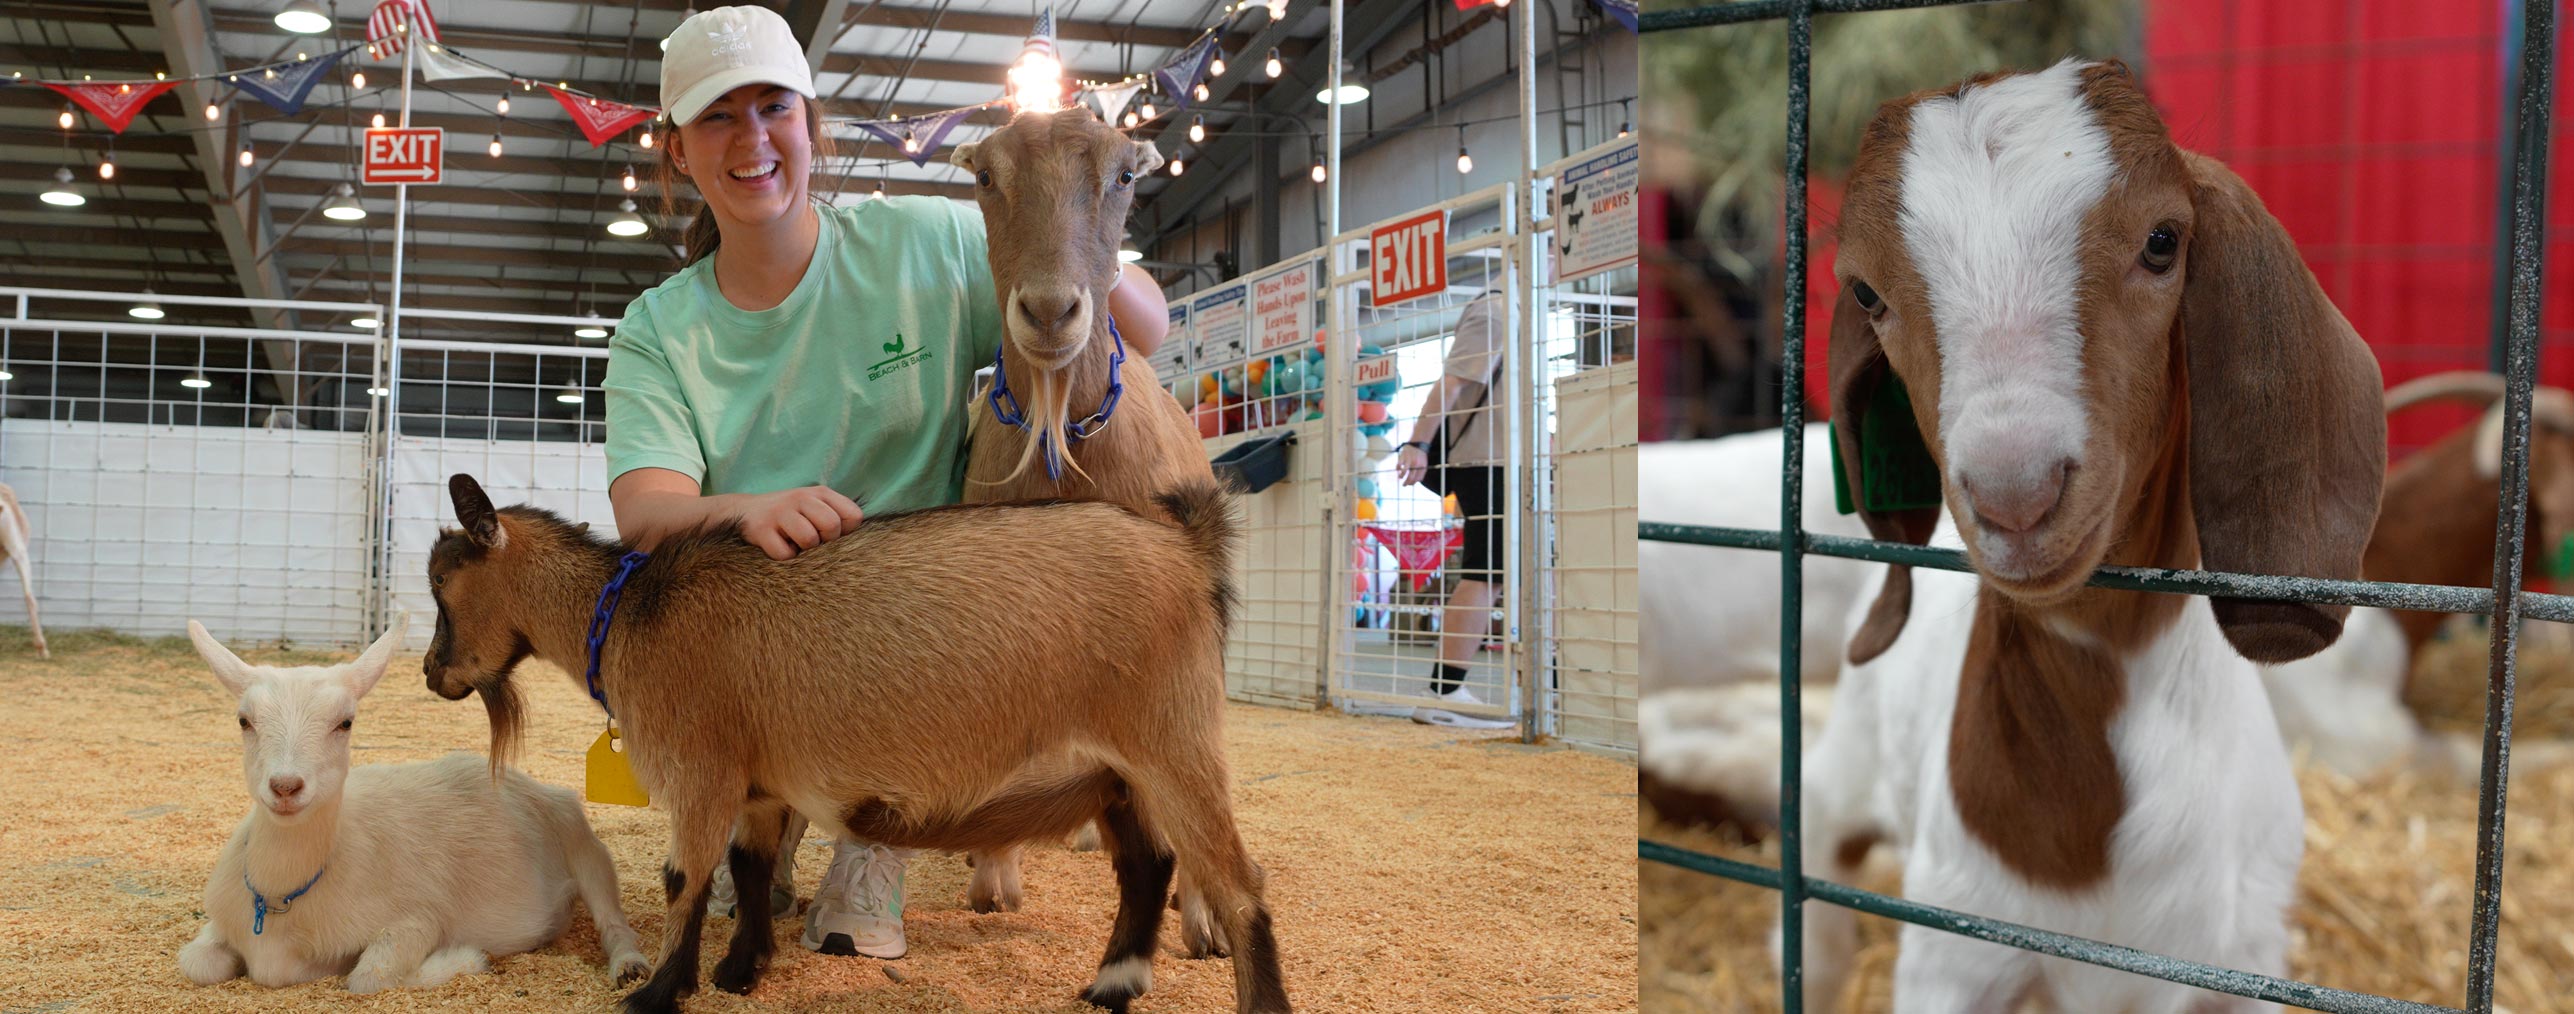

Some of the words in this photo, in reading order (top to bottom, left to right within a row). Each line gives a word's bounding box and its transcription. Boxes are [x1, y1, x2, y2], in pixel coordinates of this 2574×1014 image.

[370, 134, 438, 164] EXIT
[1592, 190, 1630, 215] ALWAYS
[1375, 218, 1440, 299] EXIT
[1257, 281, 1281, 298] Please
[1283, 270, 1306, 288] Wash
[1257, 296, 1282, 316] Hands
[1284, 291, 1307, 308] Upon
[1265, 311, 1297, 331] Leaving
[1262, 334, 1275, 349] the
[1276, 330, 1299, 345] Farm
[868, 364, 899, 381] BEACH
[901, 360, 909, 369] &
[910, 352, 932, 365] BARN
[1358, 359, 1390, 382] Pull
